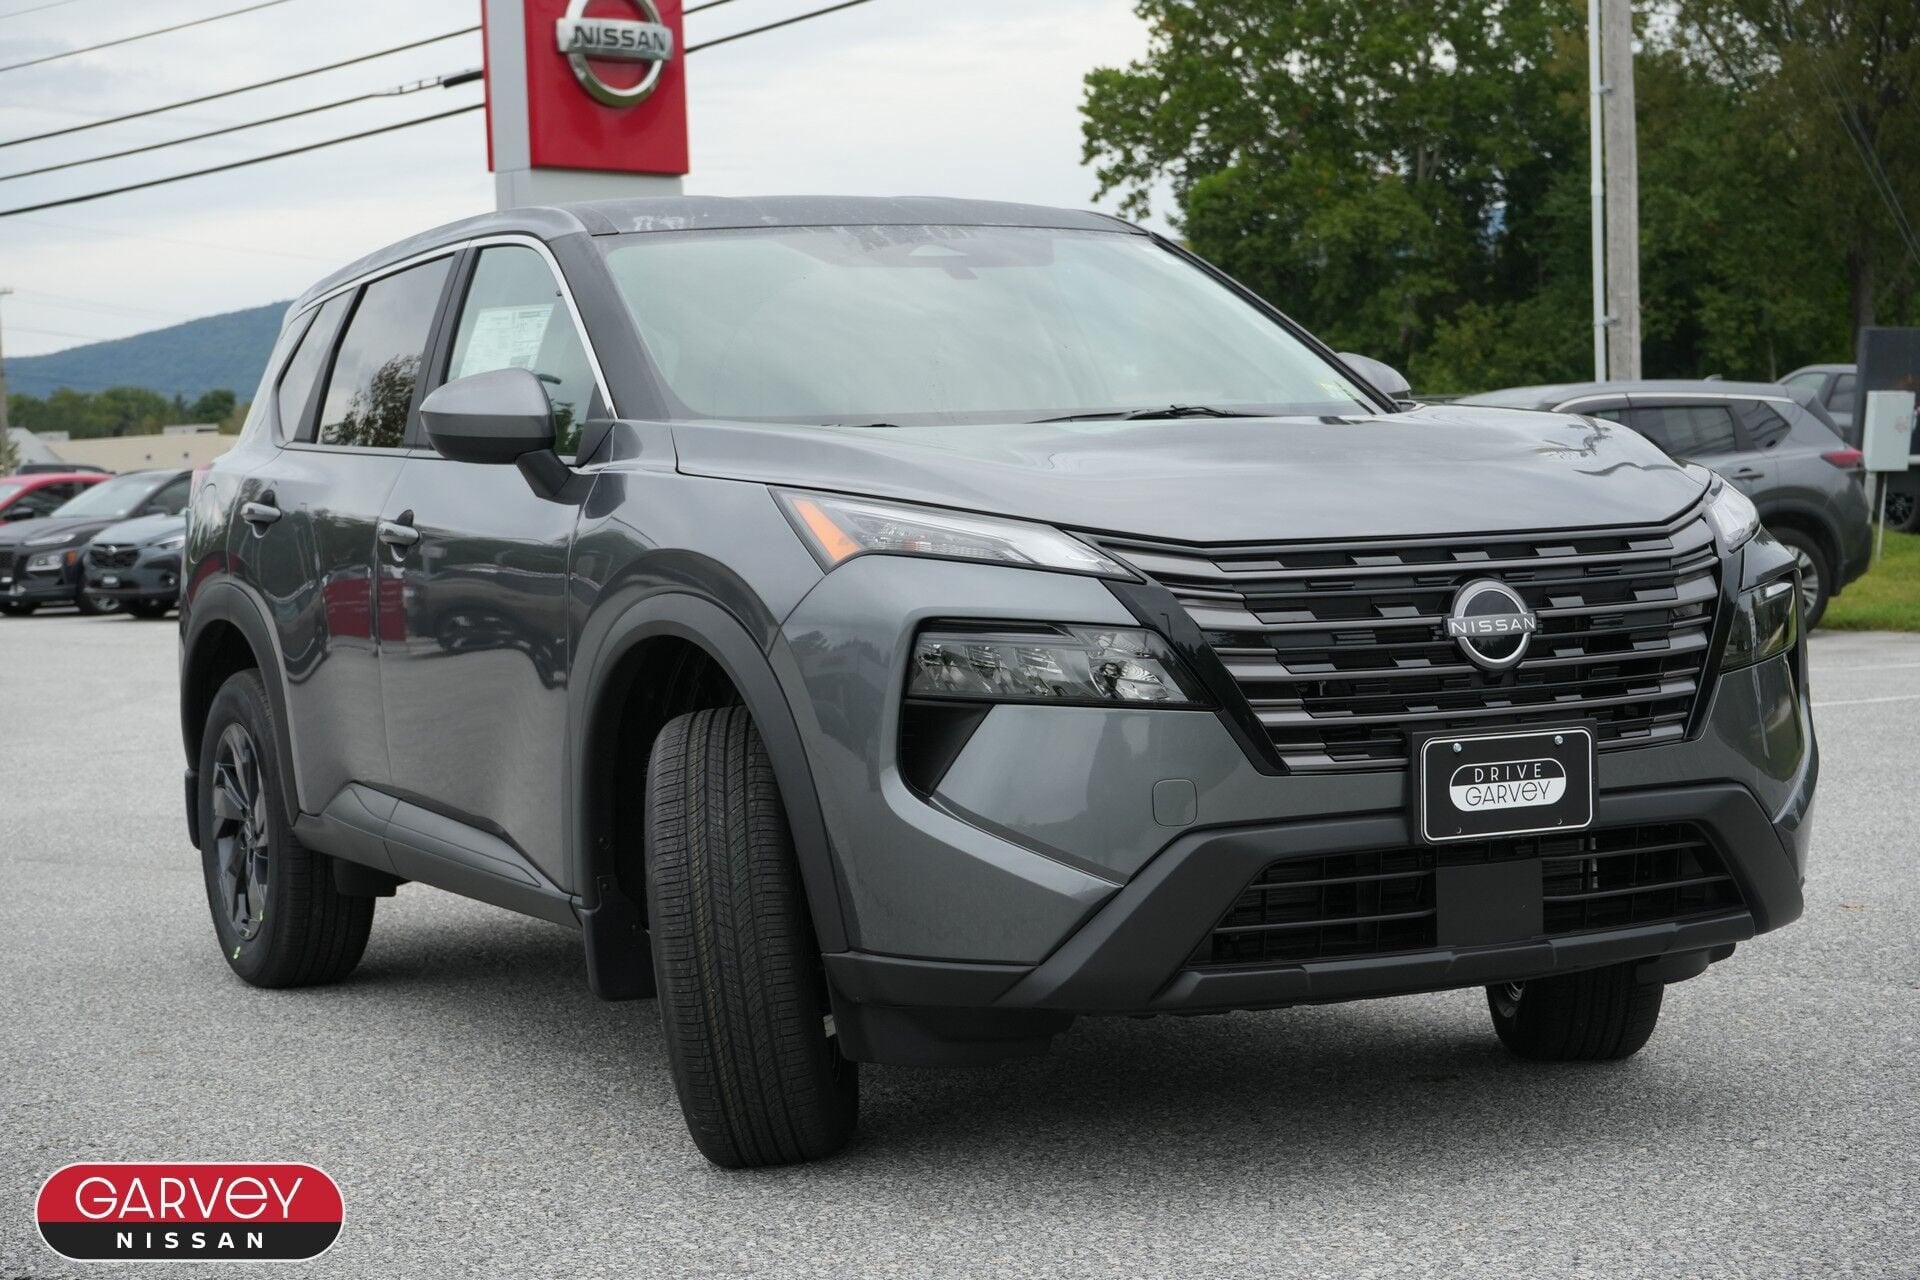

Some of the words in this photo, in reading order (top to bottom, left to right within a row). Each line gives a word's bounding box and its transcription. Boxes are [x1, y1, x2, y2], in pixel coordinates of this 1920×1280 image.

[573, 25, 666, 51] NISSAN
[1451, 617, 1535, 634] NISSAN
[1474, 763, 1542, 783] DRIVE
